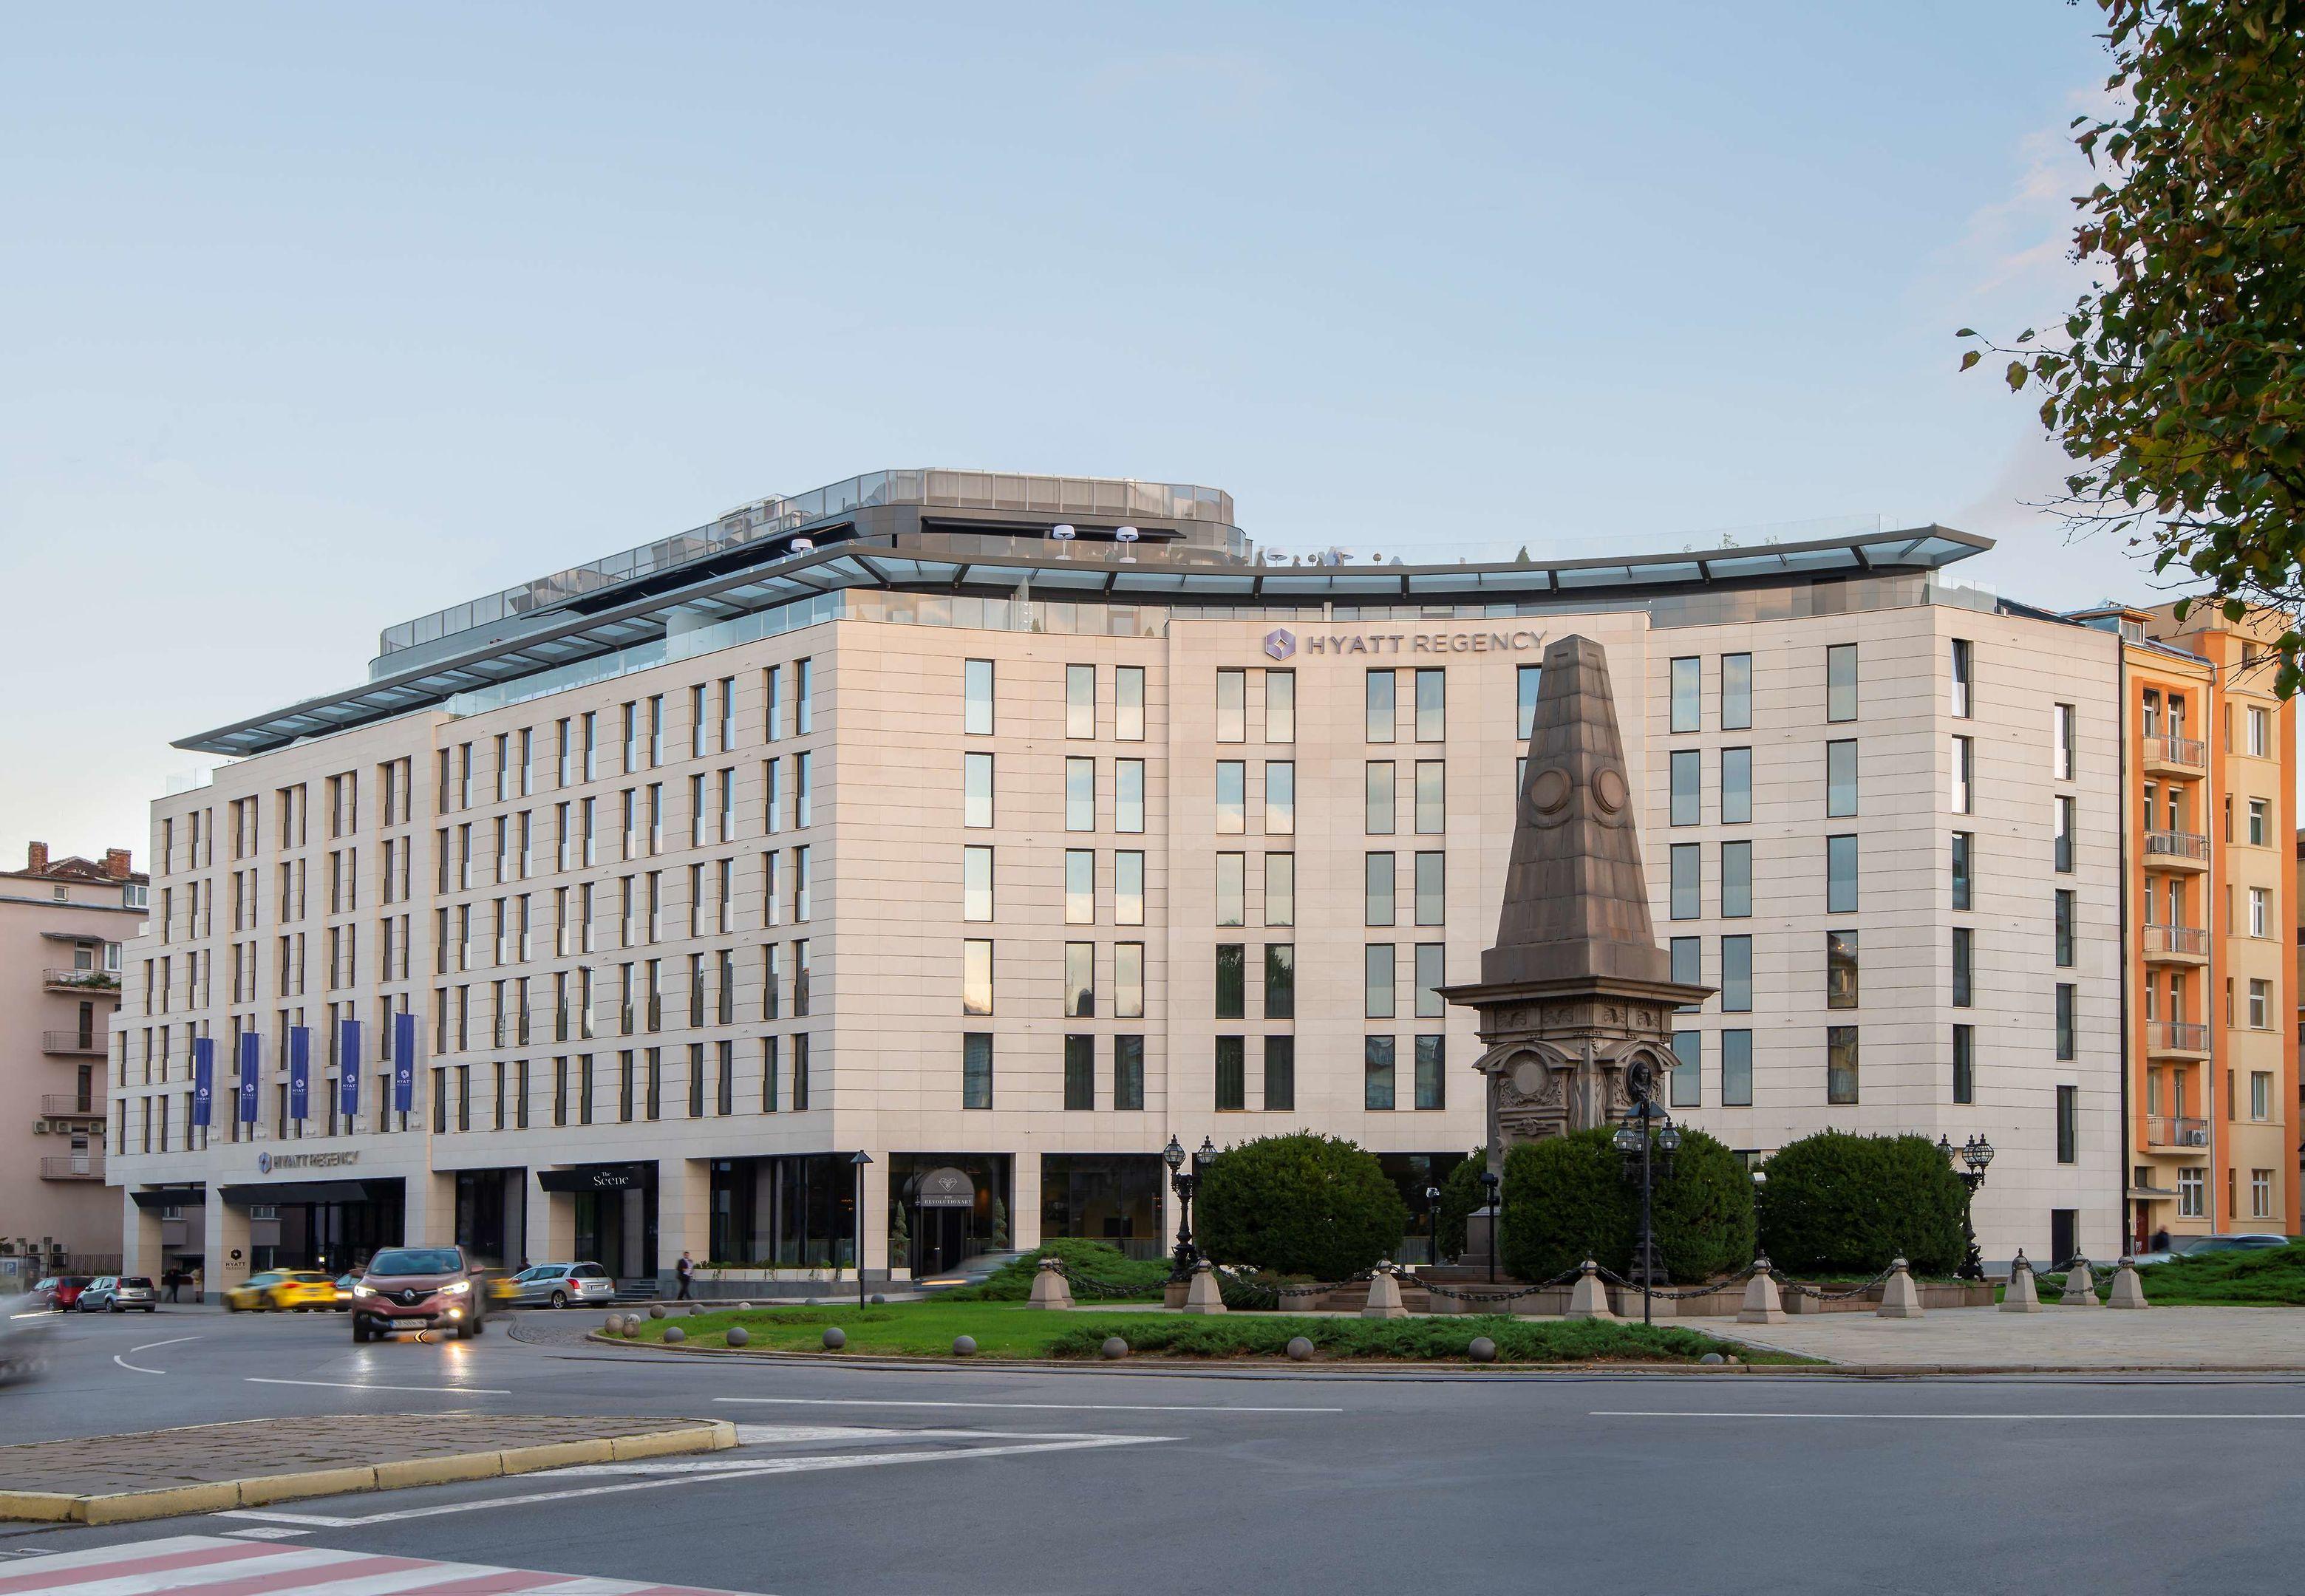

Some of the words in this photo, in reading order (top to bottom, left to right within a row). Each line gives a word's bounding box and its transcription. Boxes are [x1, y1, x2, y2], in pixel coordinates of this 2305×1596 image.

[1308, 634, 1404, 655] HYATT
[1414, 630, 1548, 653] REGENCY
[273, 1154, 309, 1168] HYATT
[310, 1150, 359, 1167] REGENCY
[593, 1176, 629, 1187] Scene
